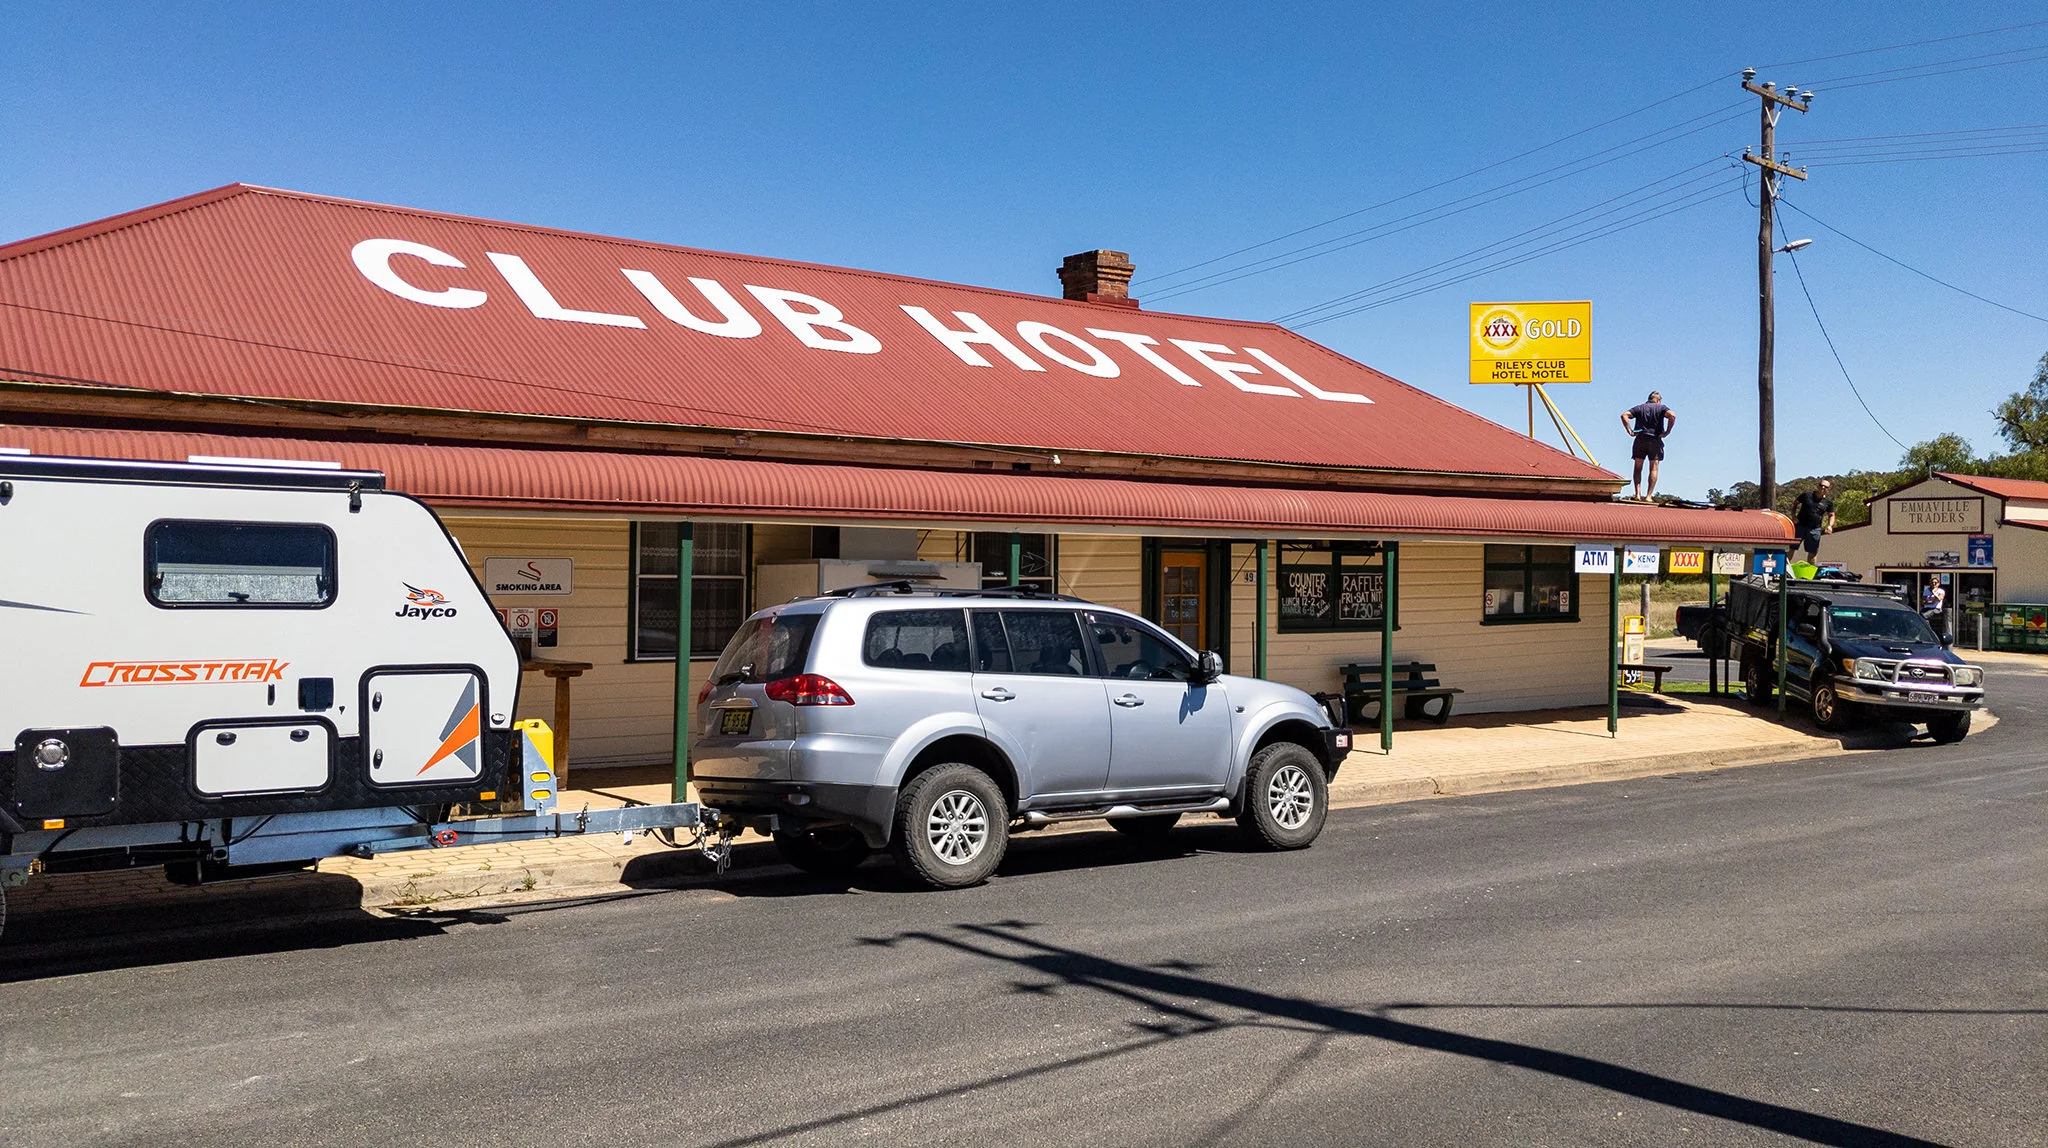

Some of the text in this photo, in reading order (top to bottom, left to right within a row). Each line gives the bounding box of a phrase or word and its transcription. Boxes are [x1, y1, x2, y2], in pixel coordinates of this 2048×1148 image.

[351, 238, 1375, 404] CLUB HOTEL
[1483, 318, 1582, 339] XXXX GOLD
[1495, 360, 1566, 370] RILEYS CLUB
[1492, 370, 1569, 380] HOTEL MOTEL
[1901, 501, 1969, 513] EMMAVILLE
[1909, 513, 1965, 523] TRADERS
[1582, 551, 1608, 566] ATM
[1638, 555, 1656, 563] KENO
[1674, 552, 1699, 567] XXXX
[1289, 573, 1327, 588] COUNTER
[1295, 586, 1323, 598] MEALS
[1282, 597, 1300, 607] LUNCH
[395, 604, 457, 620] Jayco
[80, 659, 290, 687] CROSSTRAK
